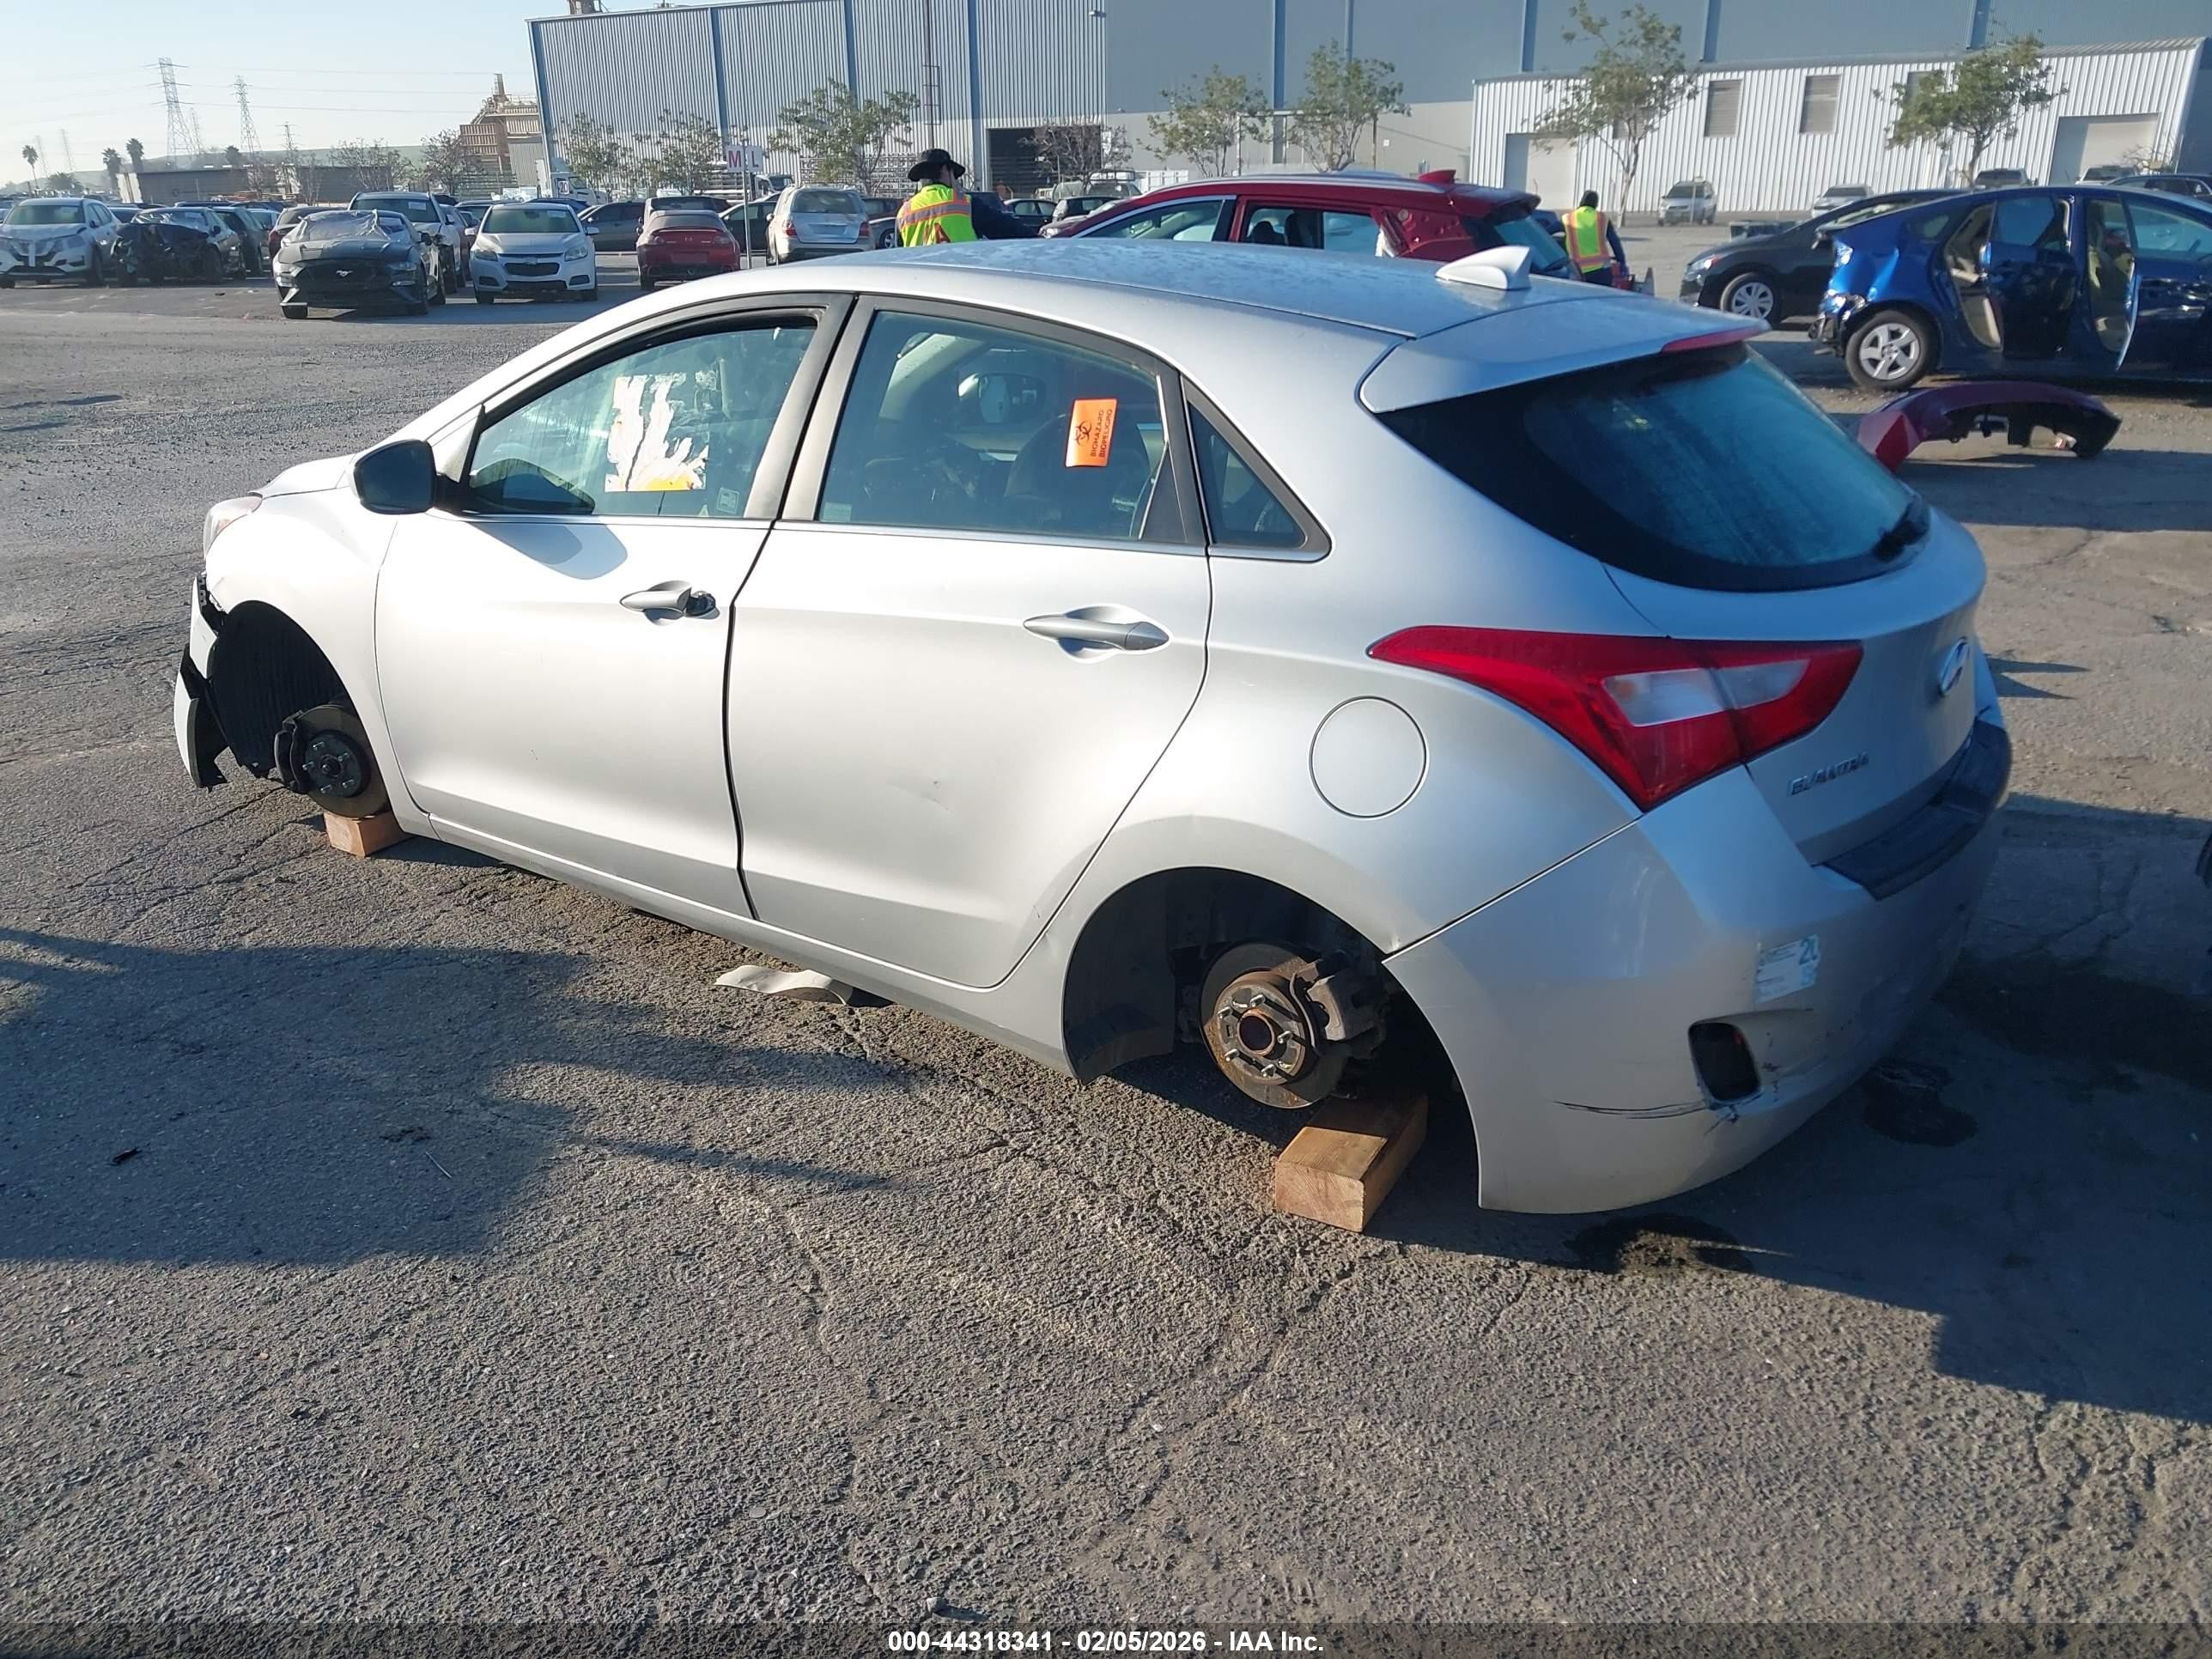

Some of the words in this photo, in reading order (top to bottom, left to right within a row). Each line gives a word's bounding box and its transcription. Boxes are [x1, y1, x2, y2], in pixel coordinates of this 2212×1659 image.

[727, 149, 743, 168] M
[750, 150, 760, 168] L
[1090, 409, 1104, 457] BIOHAZARD
[1098, 409, 1113, 458] BIOPELIGRO
[1788, 751, 1869, 796] ELANTRA
